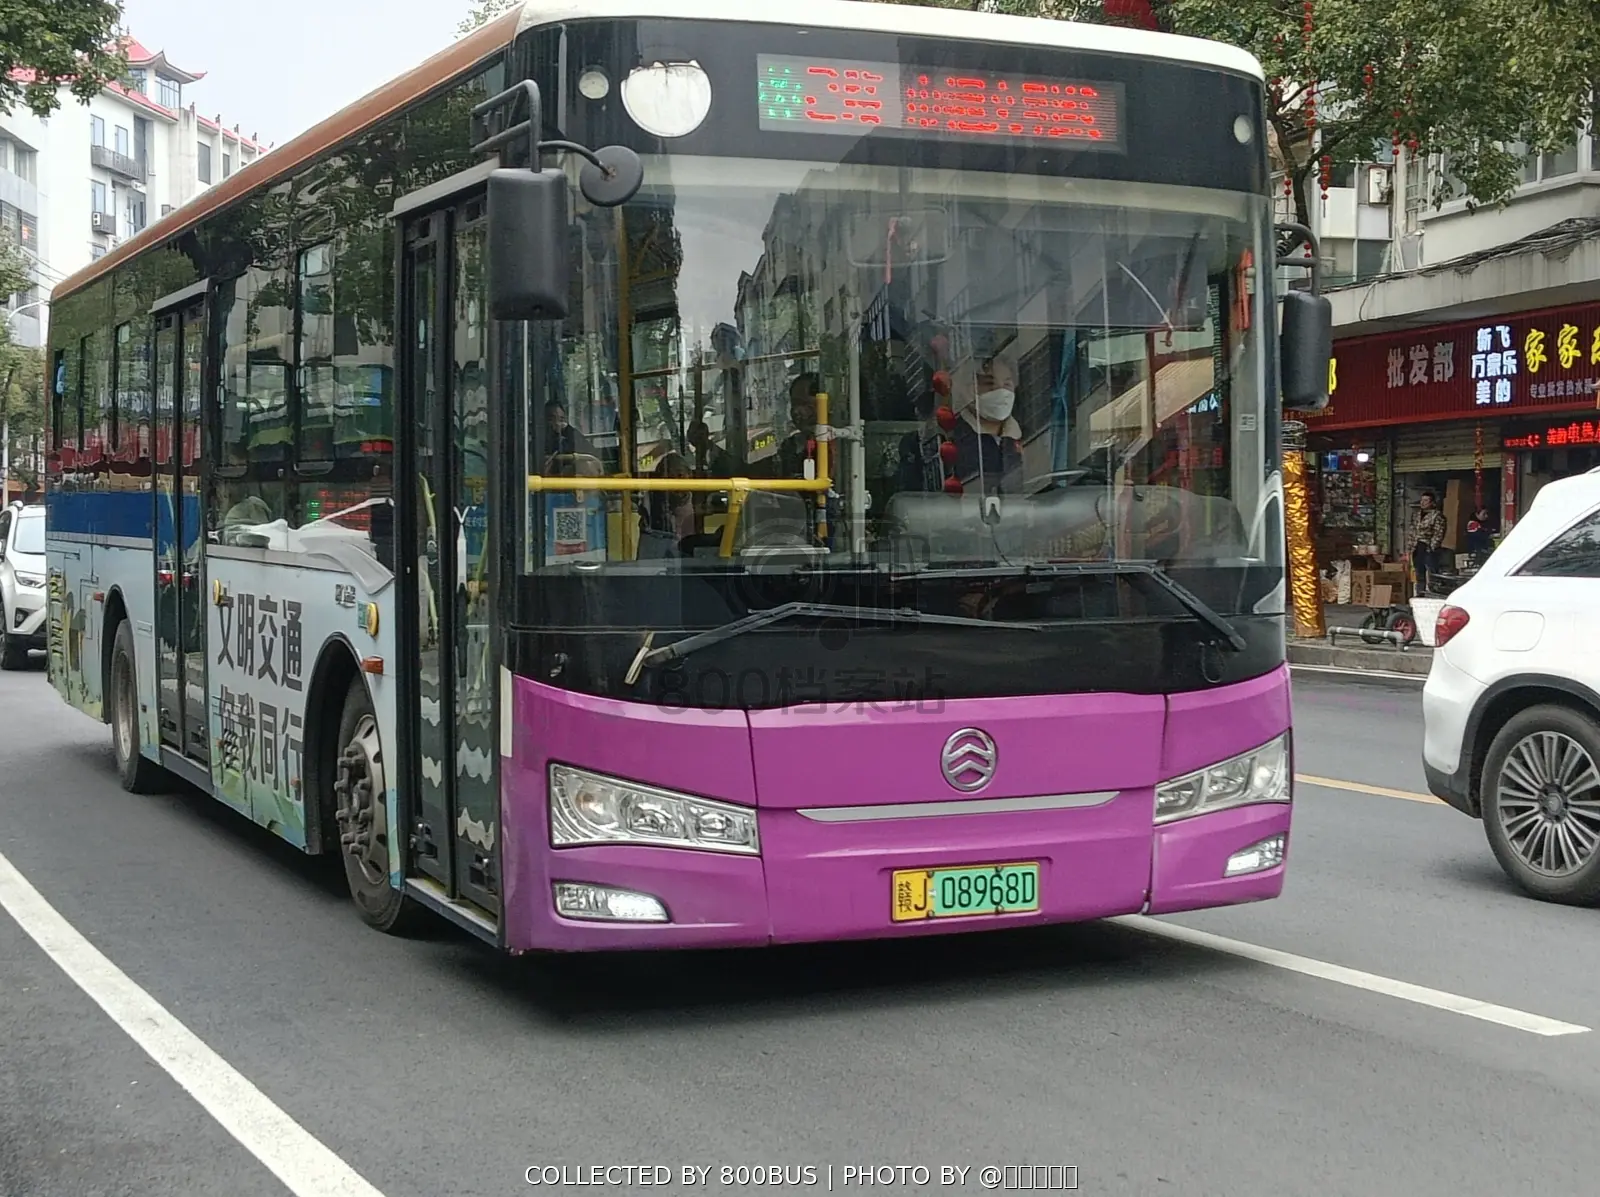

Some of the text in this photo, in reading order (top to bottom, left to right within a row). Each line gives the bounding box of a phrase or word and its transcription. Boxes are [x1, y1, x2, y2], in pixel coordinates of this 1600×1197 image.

[1477, 325, 1511, 352] 新飞
[1387, 341, 1454, 389] 批发部
[1471, 350, 1518, 379] 万家乐
[1476, 378, 1511, 404] 美的
[217, 587, 302, 692] 文明交通
